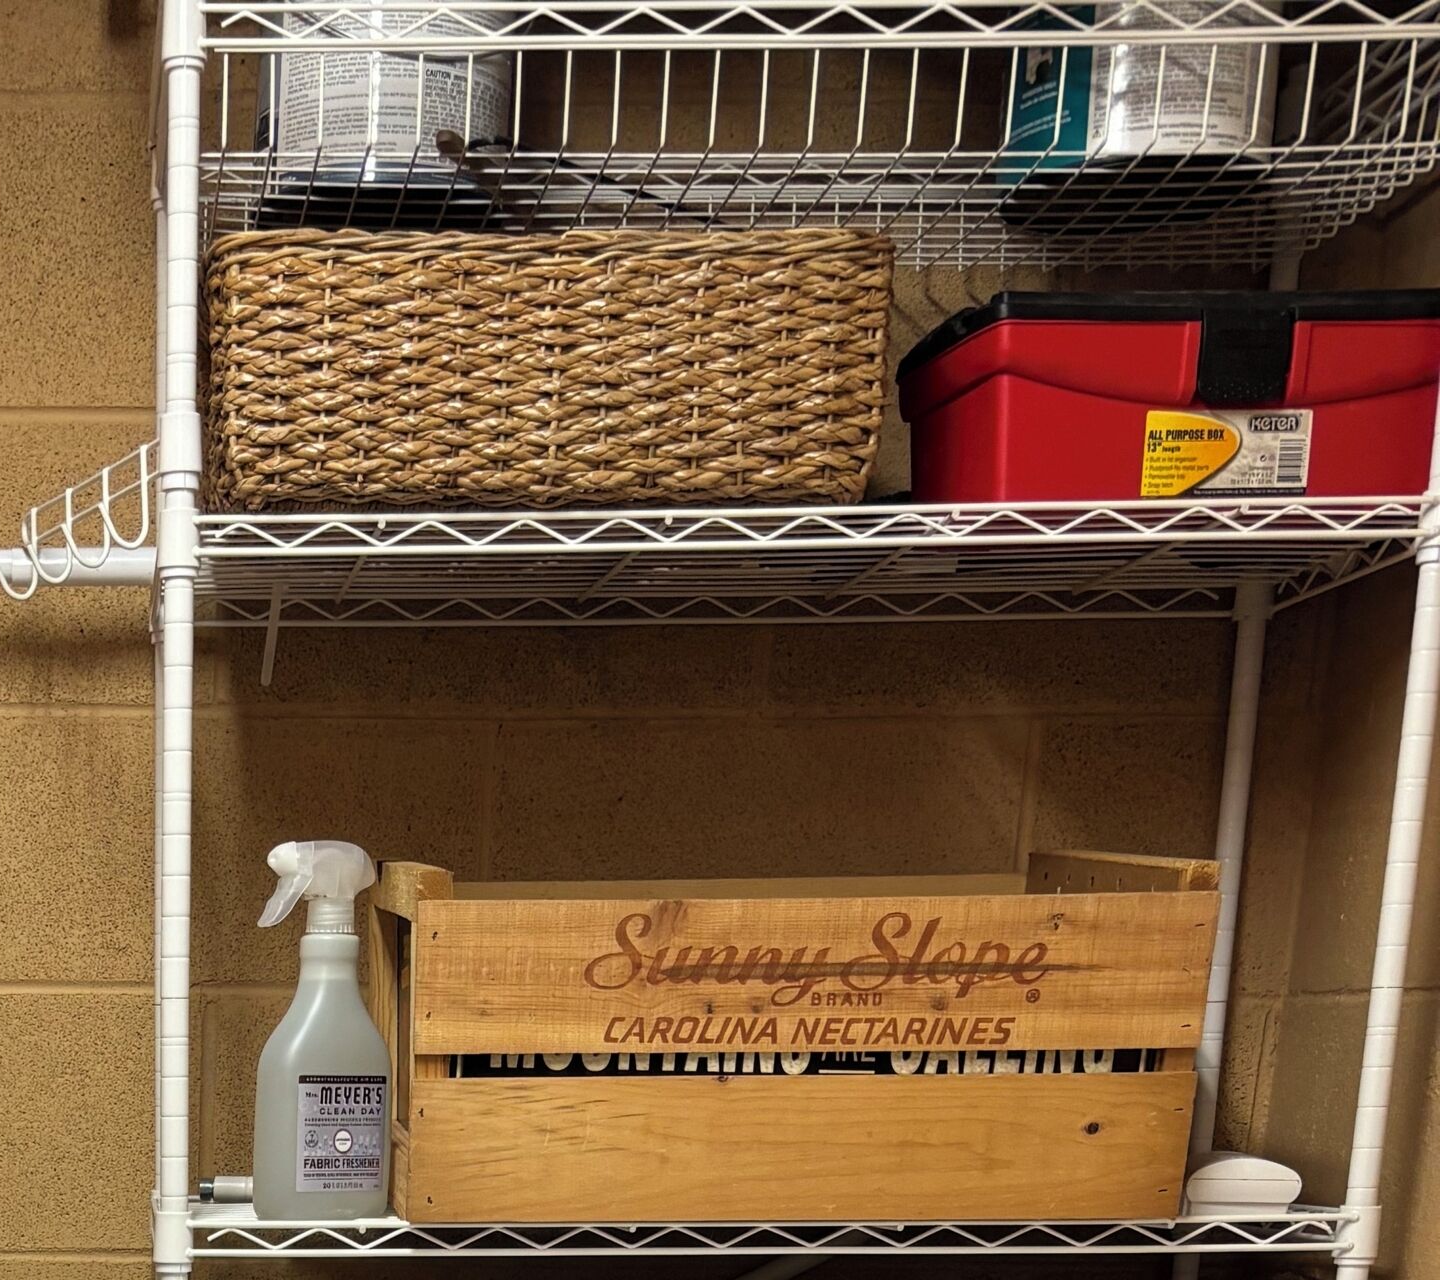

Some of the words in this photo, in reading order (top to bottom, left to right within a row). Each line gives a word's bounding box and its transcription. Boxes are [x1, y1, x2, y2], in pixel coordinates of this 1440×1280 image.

[426, 69, 451, 80] CAUTION
[1251, 417, 1298, 431] KETER
[1148, 429, 1163, 441] ALL
[1166, 429, 1205, 440] PURPOSE
[1207, 429, 1225, 440] BOX
[583, 912, 832, 1007] Sunny
[840, 912, 1051, 998] Slope
[810, 992, 883, 1007] BRAND
[603, 1016, 778, 1045] CAROLINA
[791, 1016, 1016, 1045] NECTARINES
[320, 1086, 383, 1105] MEYER'S
[361, 1107, 381, 1115] DAY
[304, 1158, 341, 1169] FABRIC
[342, 1158, 380, 1169] FRESHENER
